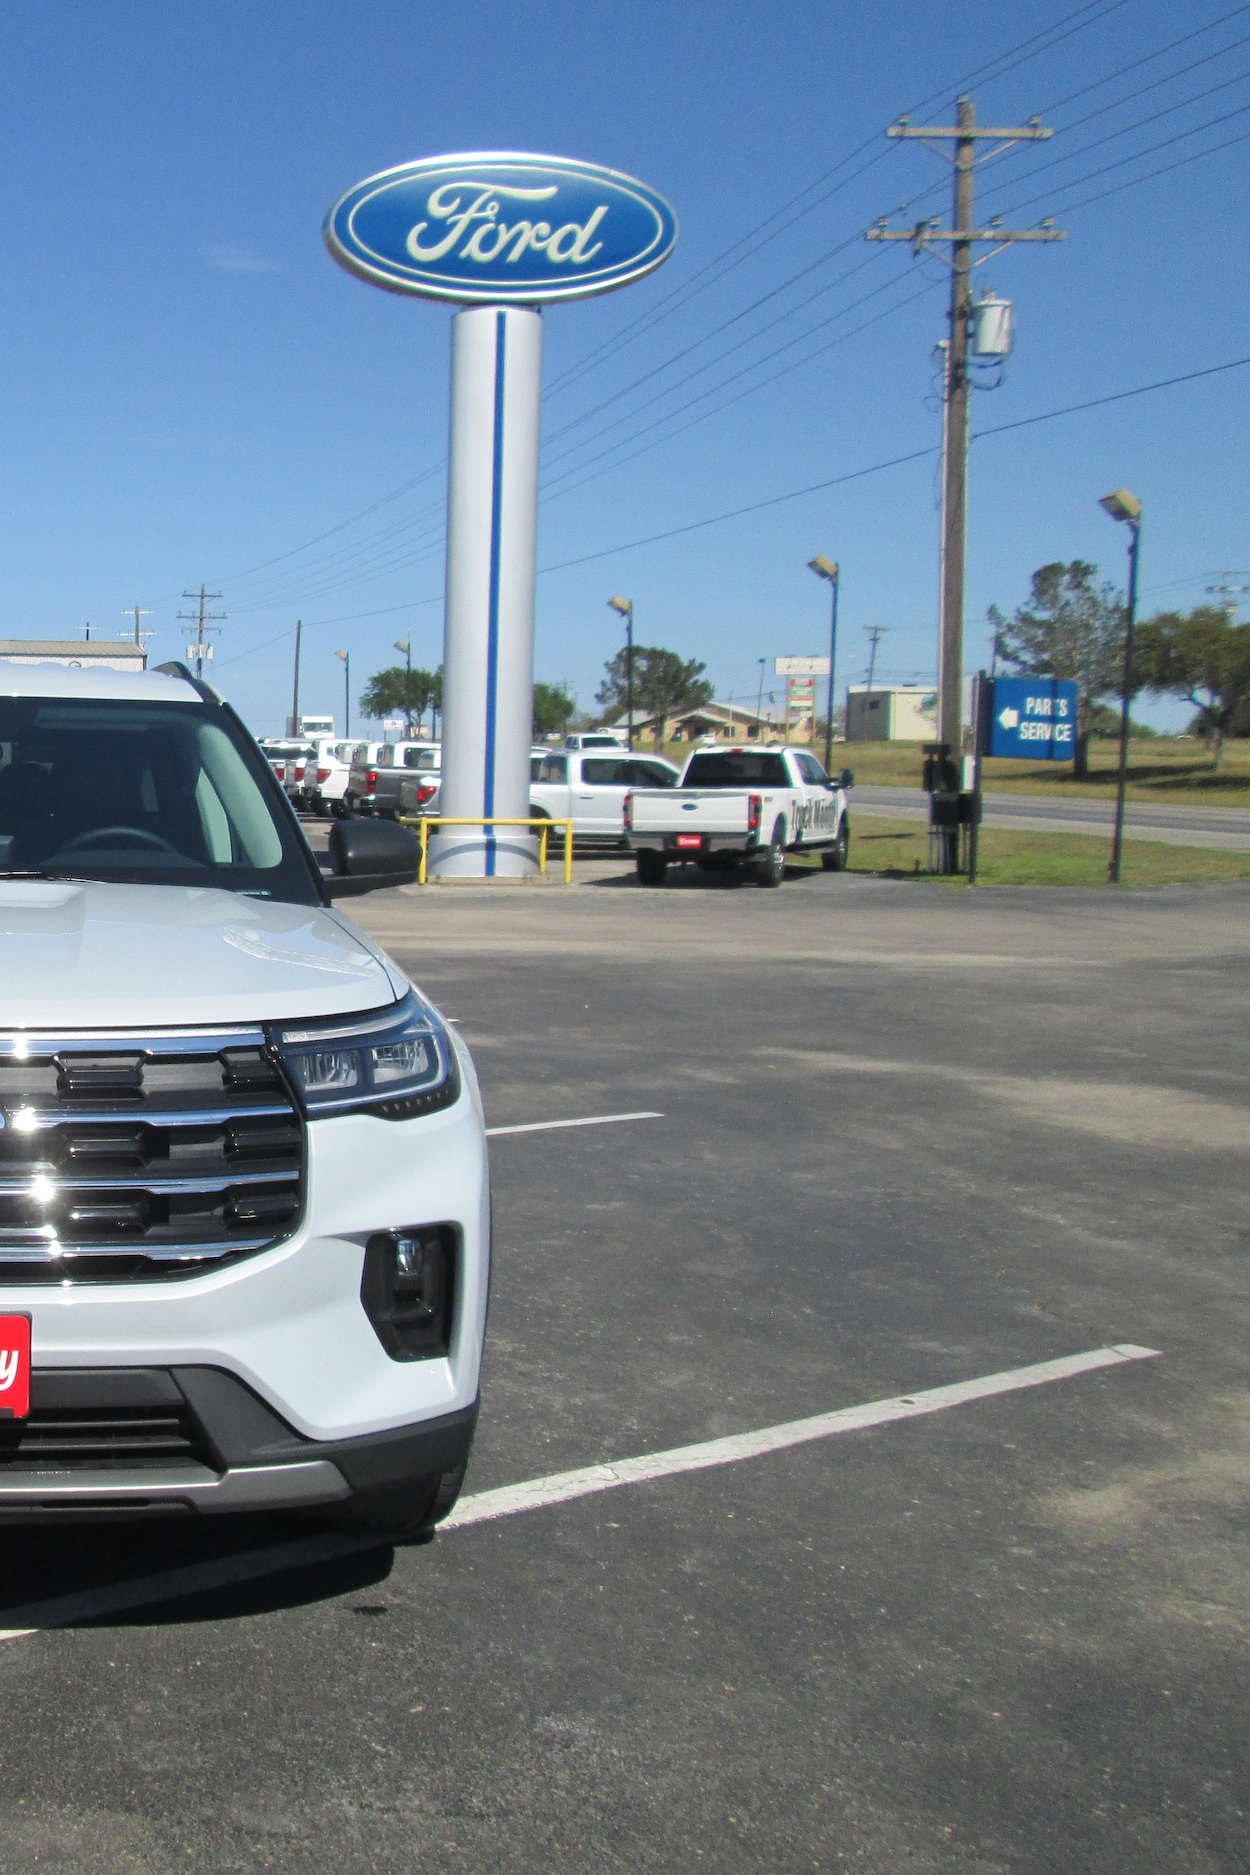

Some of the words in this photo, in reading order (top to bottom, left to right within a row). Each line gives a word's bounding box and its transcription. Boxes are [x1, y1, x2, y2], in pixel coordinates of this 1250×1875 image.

[406, 181, 609, 263] Ford
[1026, 697, 1068, 717] PARS
[1020, 722, 1072, 741] SERVCE
